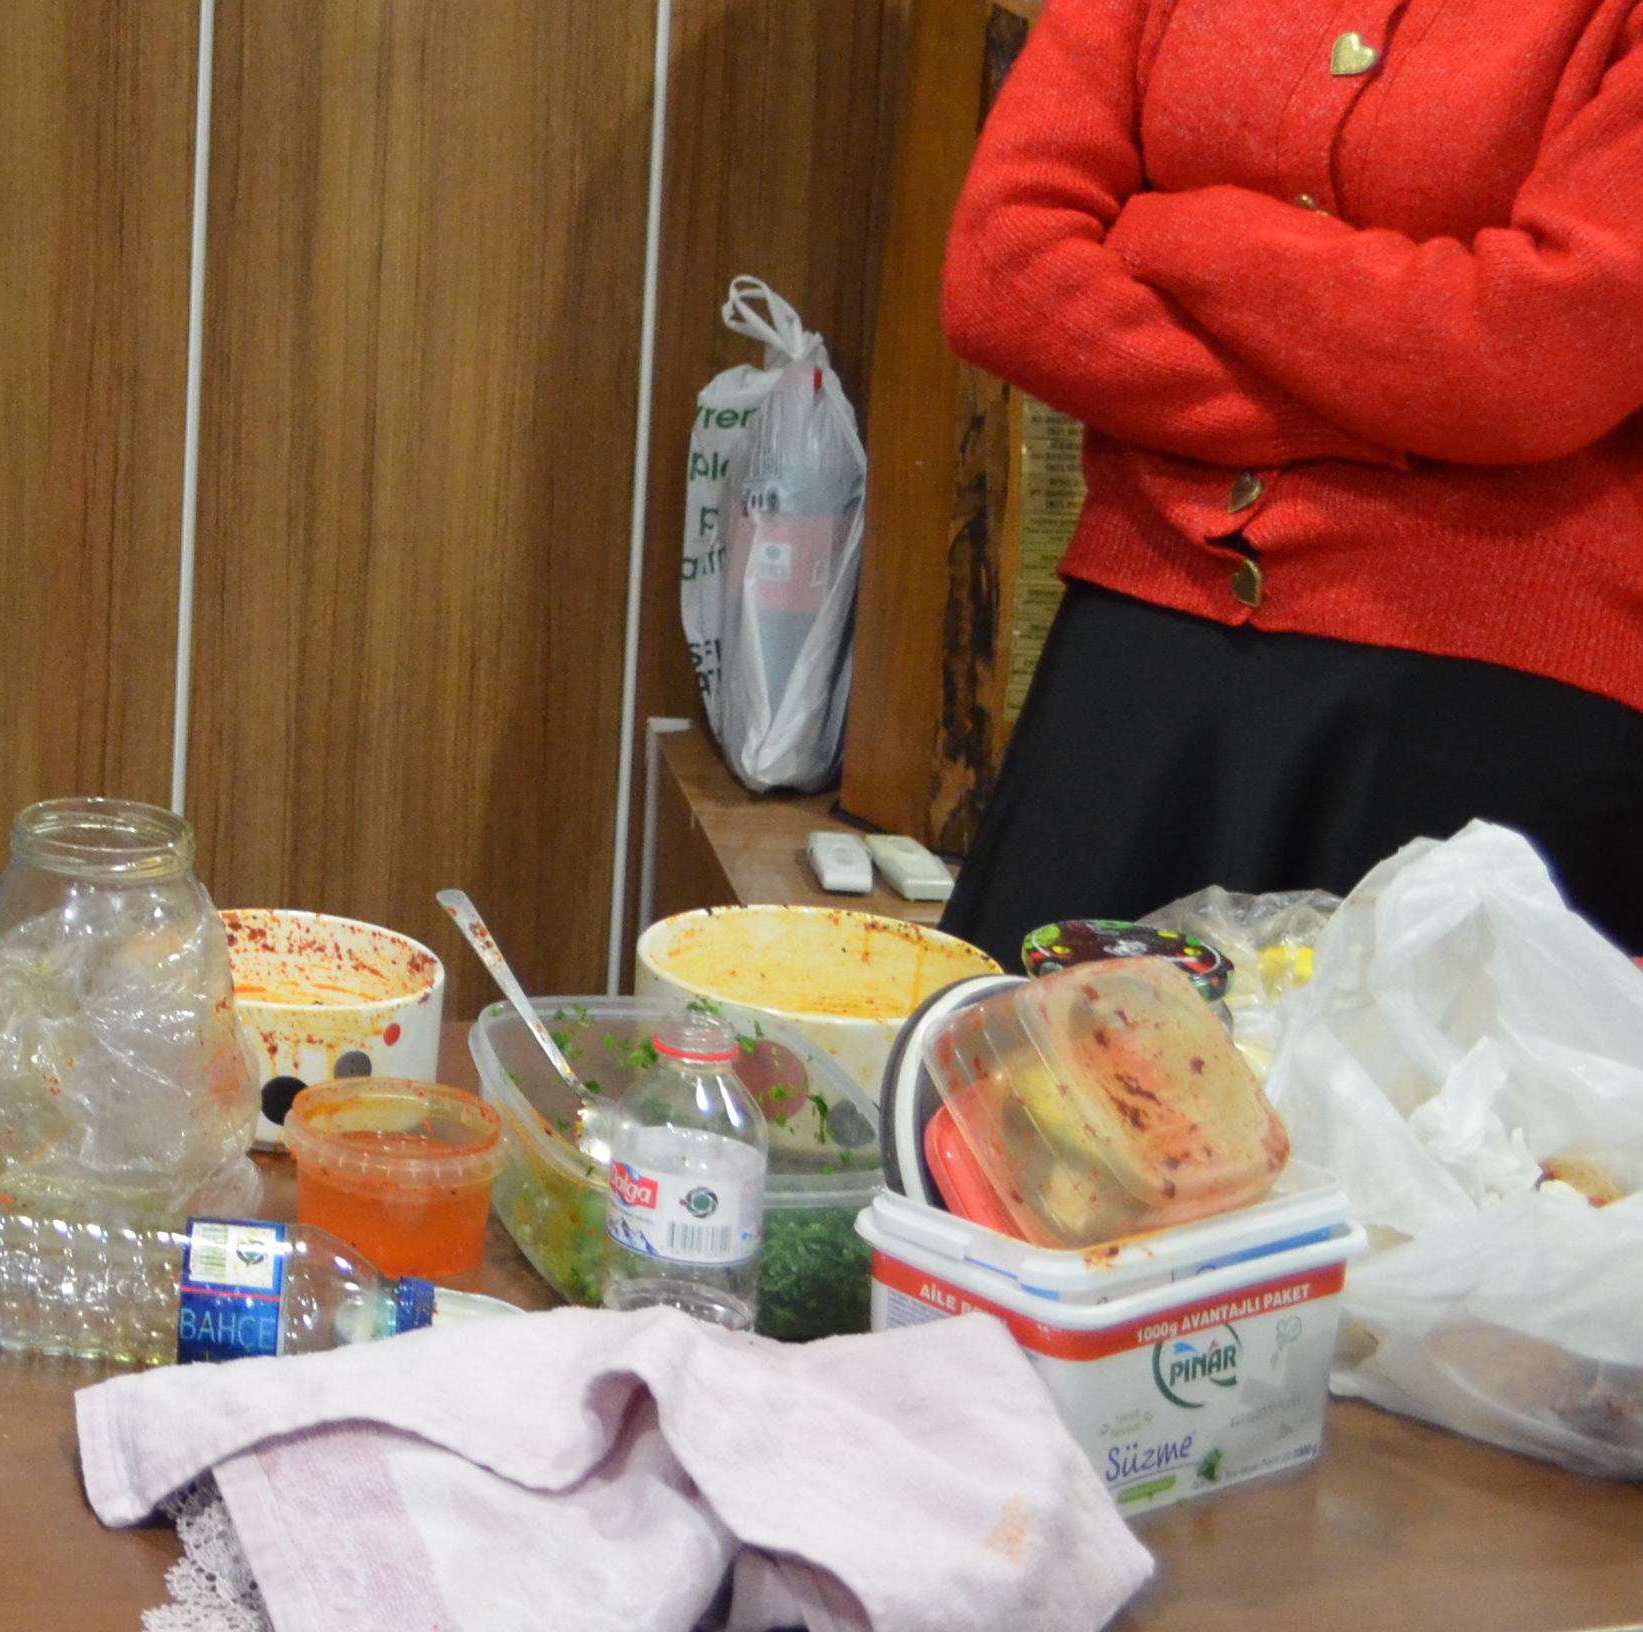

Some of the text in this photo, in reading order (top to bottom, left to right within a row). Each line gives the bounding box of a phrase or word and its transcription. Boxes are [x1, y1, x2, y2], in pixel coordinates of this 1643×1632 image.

[180, 1308, 276, 1352] BAHÇE
[1136, 1283, 1311, 1344] 1000g AVANTAJLI PAKET
[1105, 1434, 1193, 1482] Süzme
